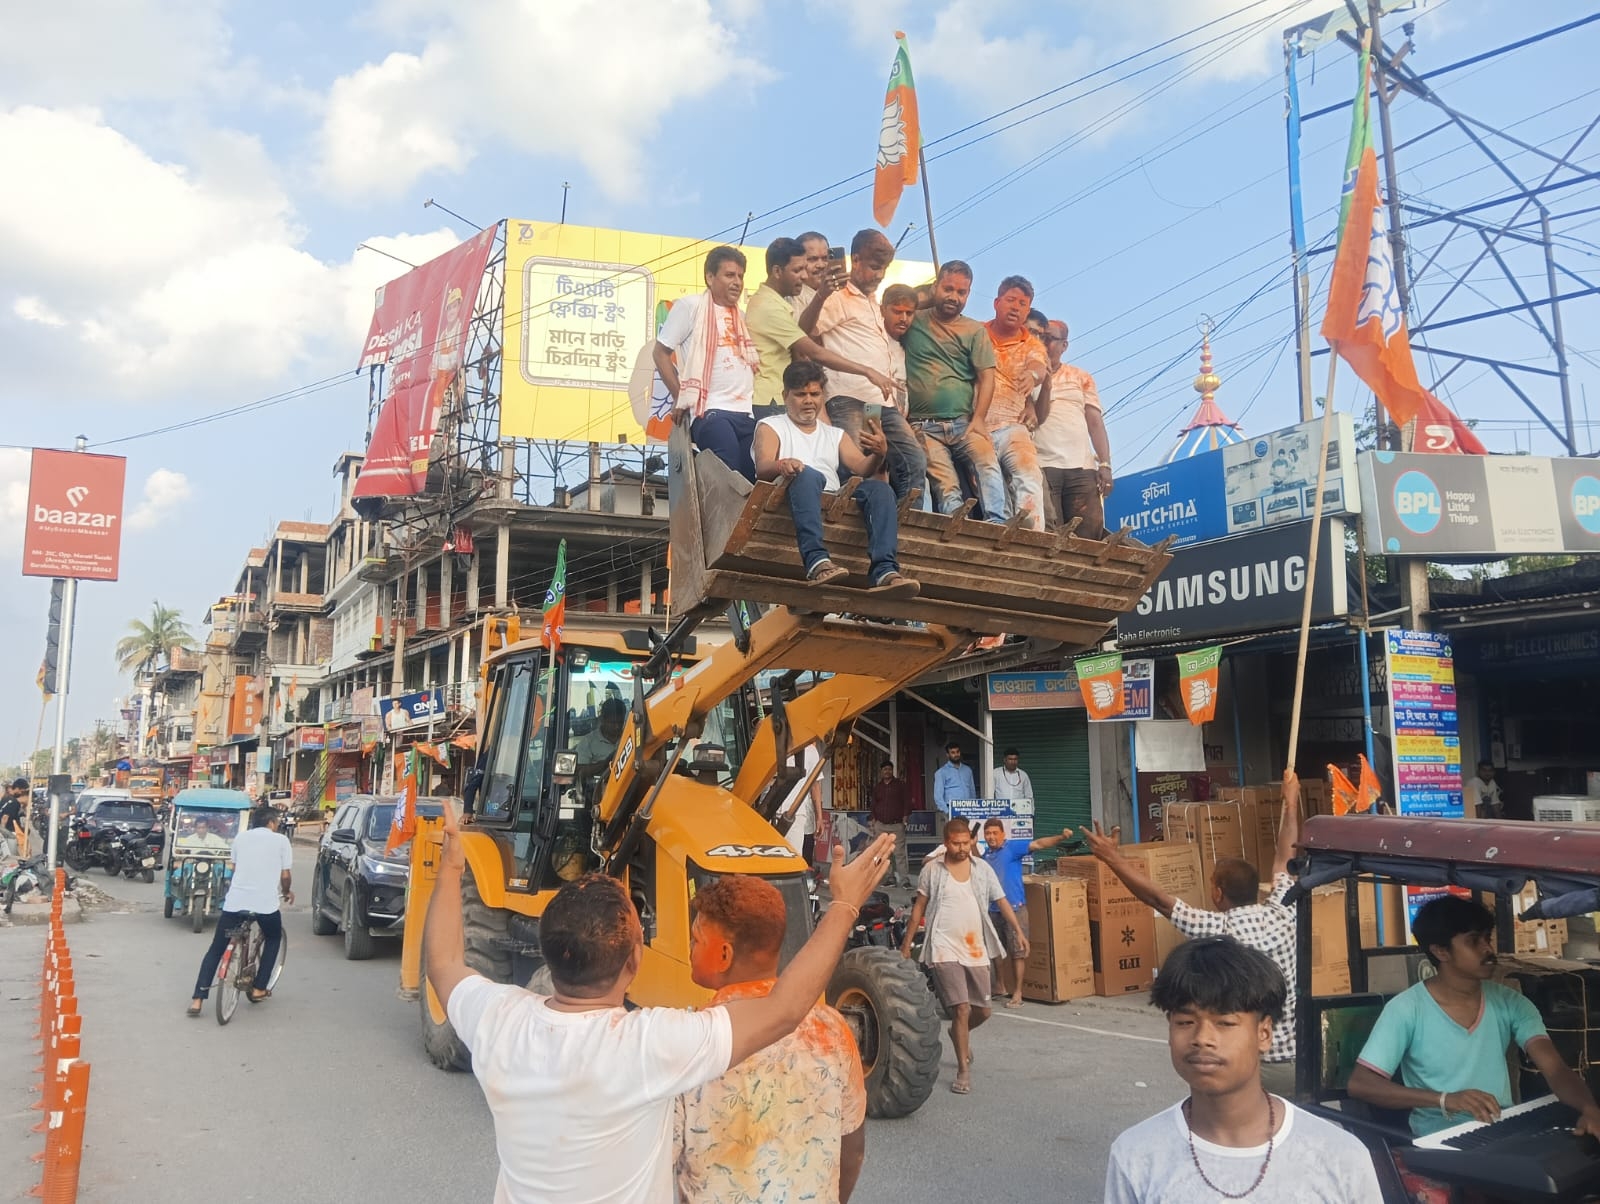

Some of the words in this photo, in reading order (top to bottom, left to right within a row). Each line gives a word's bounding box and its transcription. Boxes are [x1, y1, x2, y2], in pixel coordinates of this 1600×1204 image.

[556, 274, 615, 299] টিএমটি
[404, 311, 422, 334] KA
[549, 329, 586, 348] মানে
[590, 330, 626, 351] বাড়ি
[546, 346, 602, 368] চিরদিন
[1141, 481, 1171, 505] কুচিনা
[1397, 491, 1441, 514] BPL
[1446, 490, 1475, 503] Happy
[34, 504, 116, 528] baazar
[1447, 501, 1470, 512] Little
[1168, 517, 1199, 529] EXPERTS
[1448, 512, 1479, 525] Things
[1136, 555, 1305, 616] SAMSUNG
[1119, 630, 1137, 642] Saha
[1138, 626, 1181, 641] Electronics
[992, 679, 1036, 693] ভাওয়াল
[1124, 688, 1148, 709] EMI
[614, 737, 633, 780] JCB
[1150, 779, 1188, 795] দরকার
[952, 800, 980, 808] BHOWAL
[981, 799, 1009, 807] OPTICAL
[1119, 956, 1141, 970] IFB
